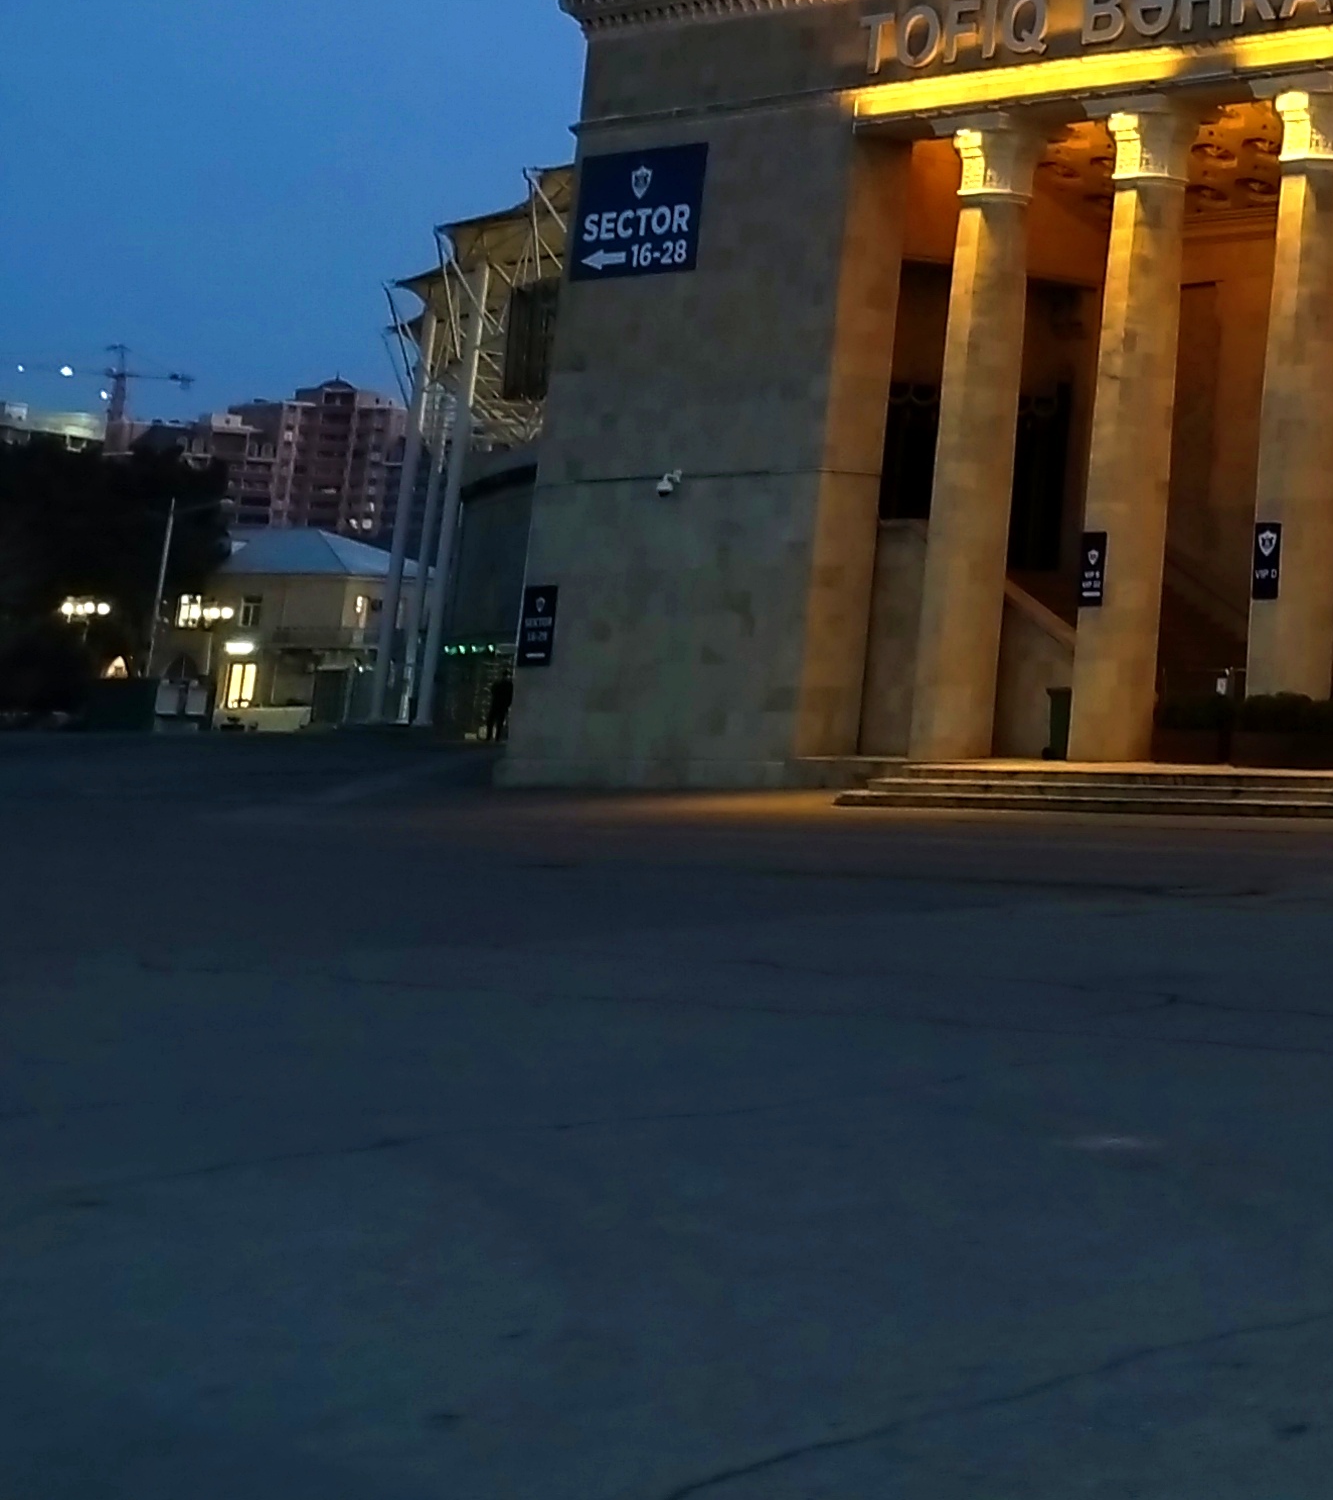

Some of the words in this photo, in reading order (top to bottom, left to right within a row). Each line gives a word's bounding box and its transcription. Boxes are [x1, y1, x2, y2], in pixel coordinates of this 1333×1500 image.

[583, 203, 690, 242] SECTOR
[631, 239, 687, 268] 16-28
[1255, 568, 1269, 579] VIP
